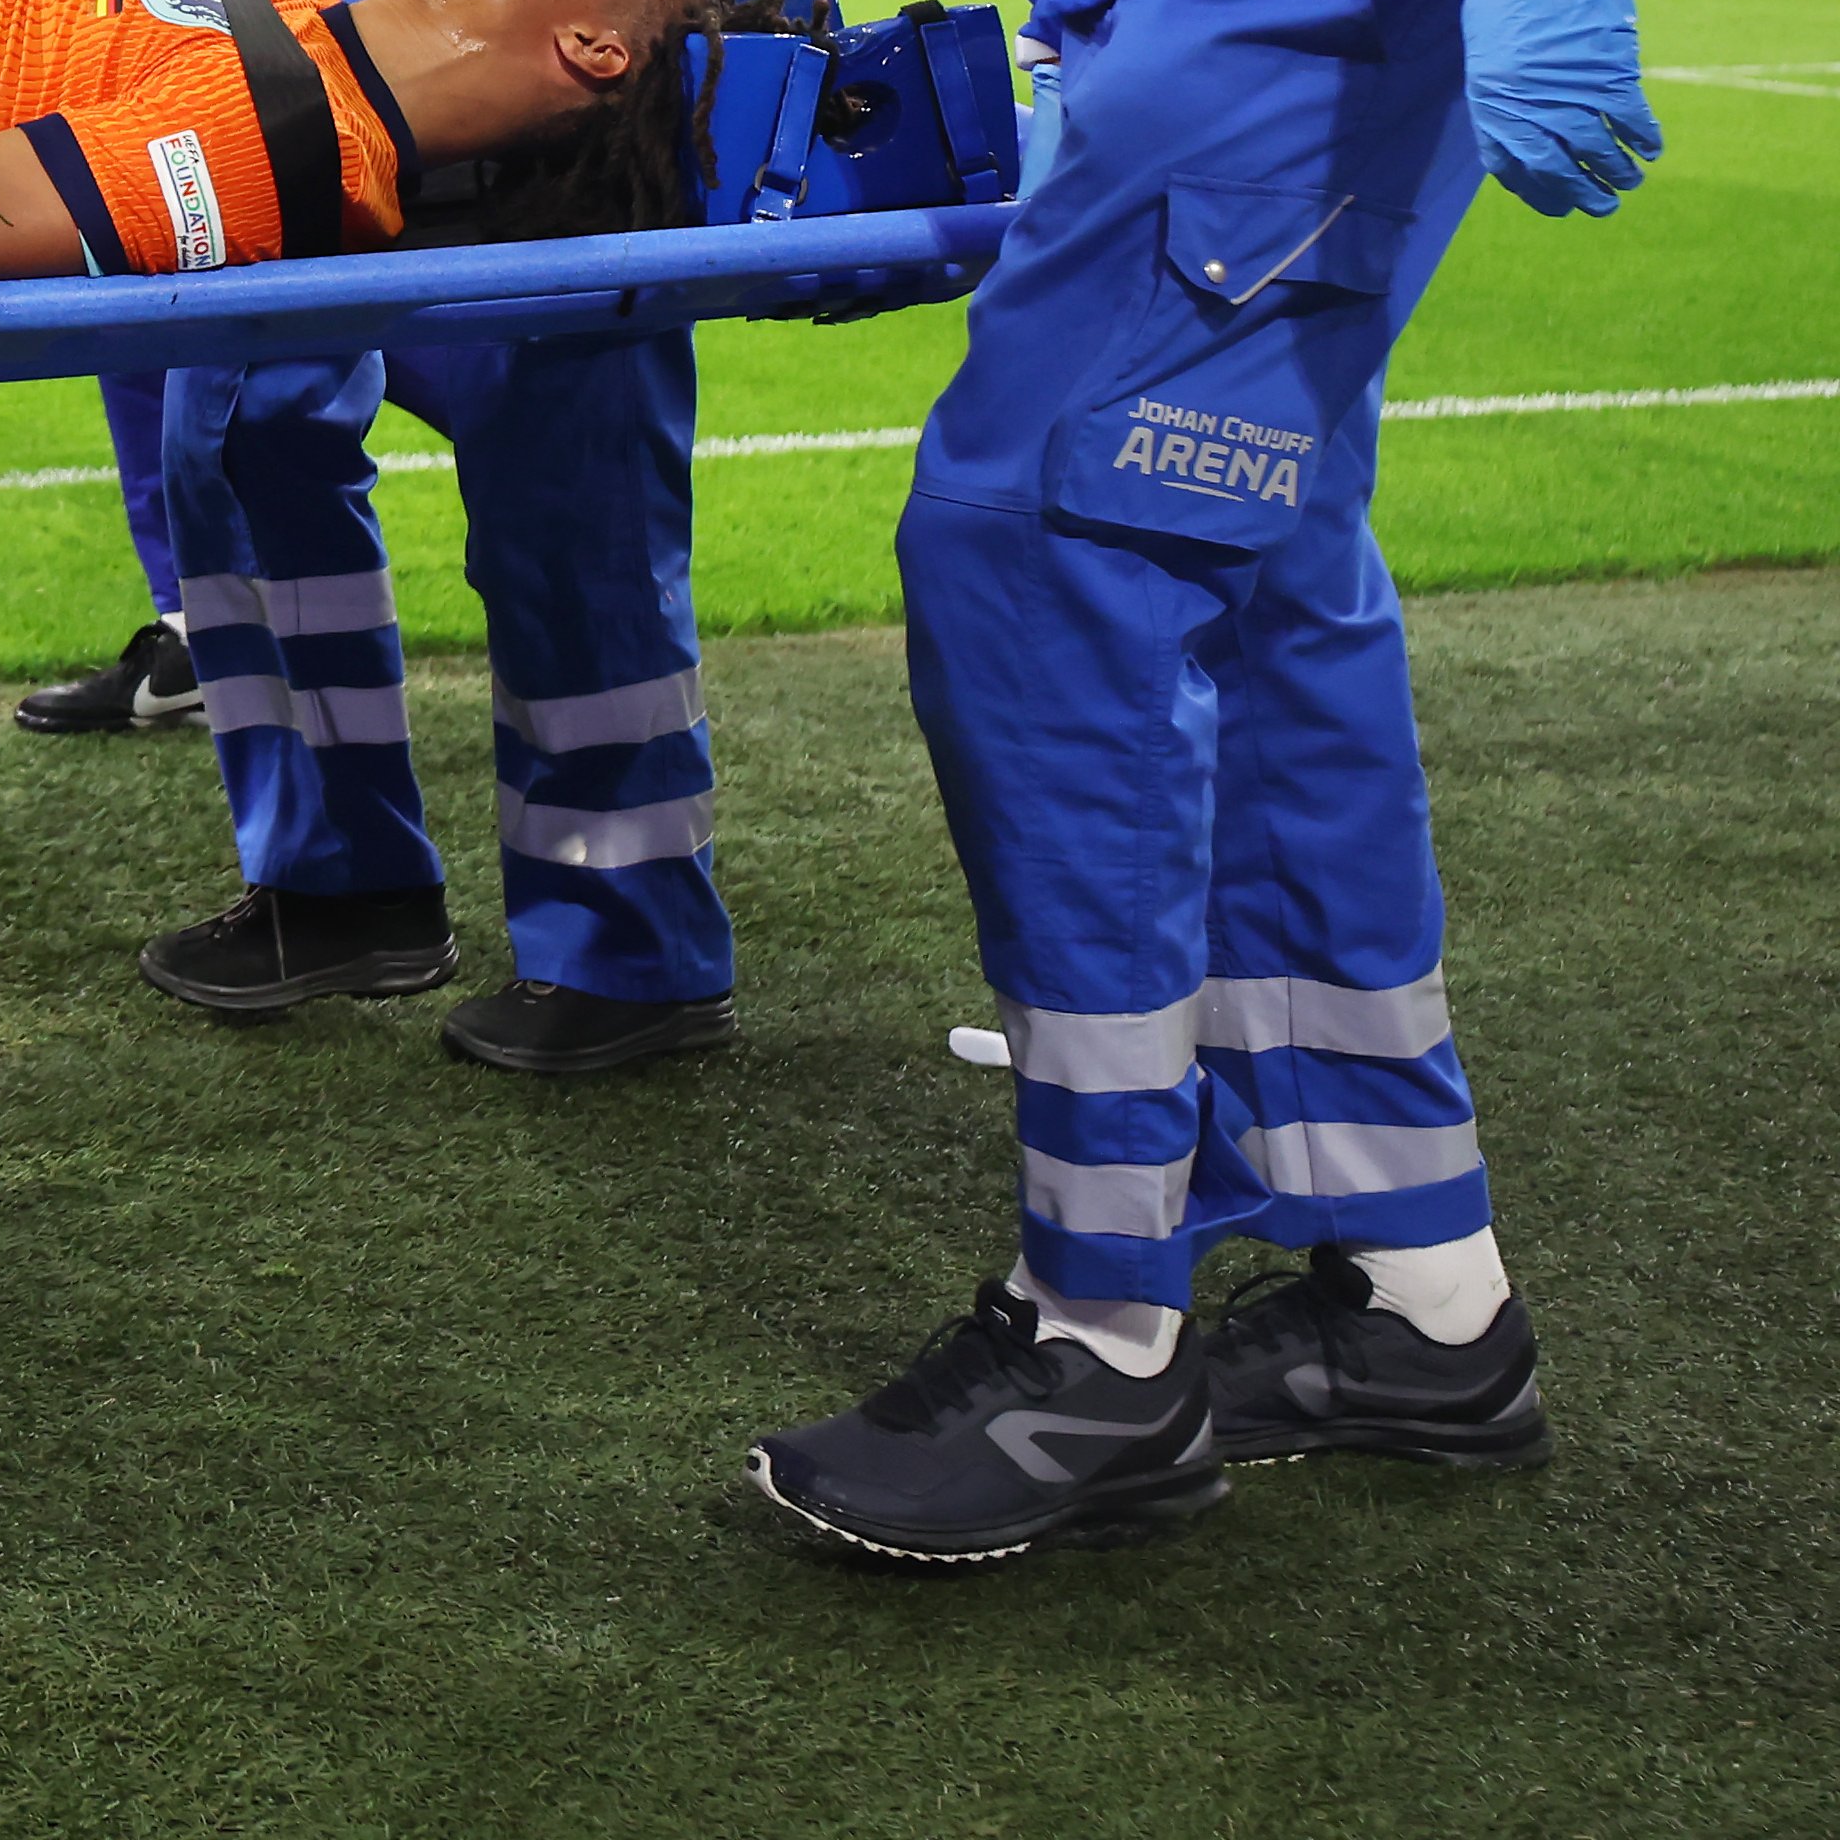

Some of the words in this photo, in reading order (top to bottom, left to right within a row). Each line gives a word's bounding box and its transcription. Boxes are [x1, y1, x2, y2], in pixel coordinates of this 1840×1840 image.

[182, 133, 200, 165] UEFA
[1127, 397, 1219, 436] JOHAN
[1112, 425, 1299, 508] ARENA
